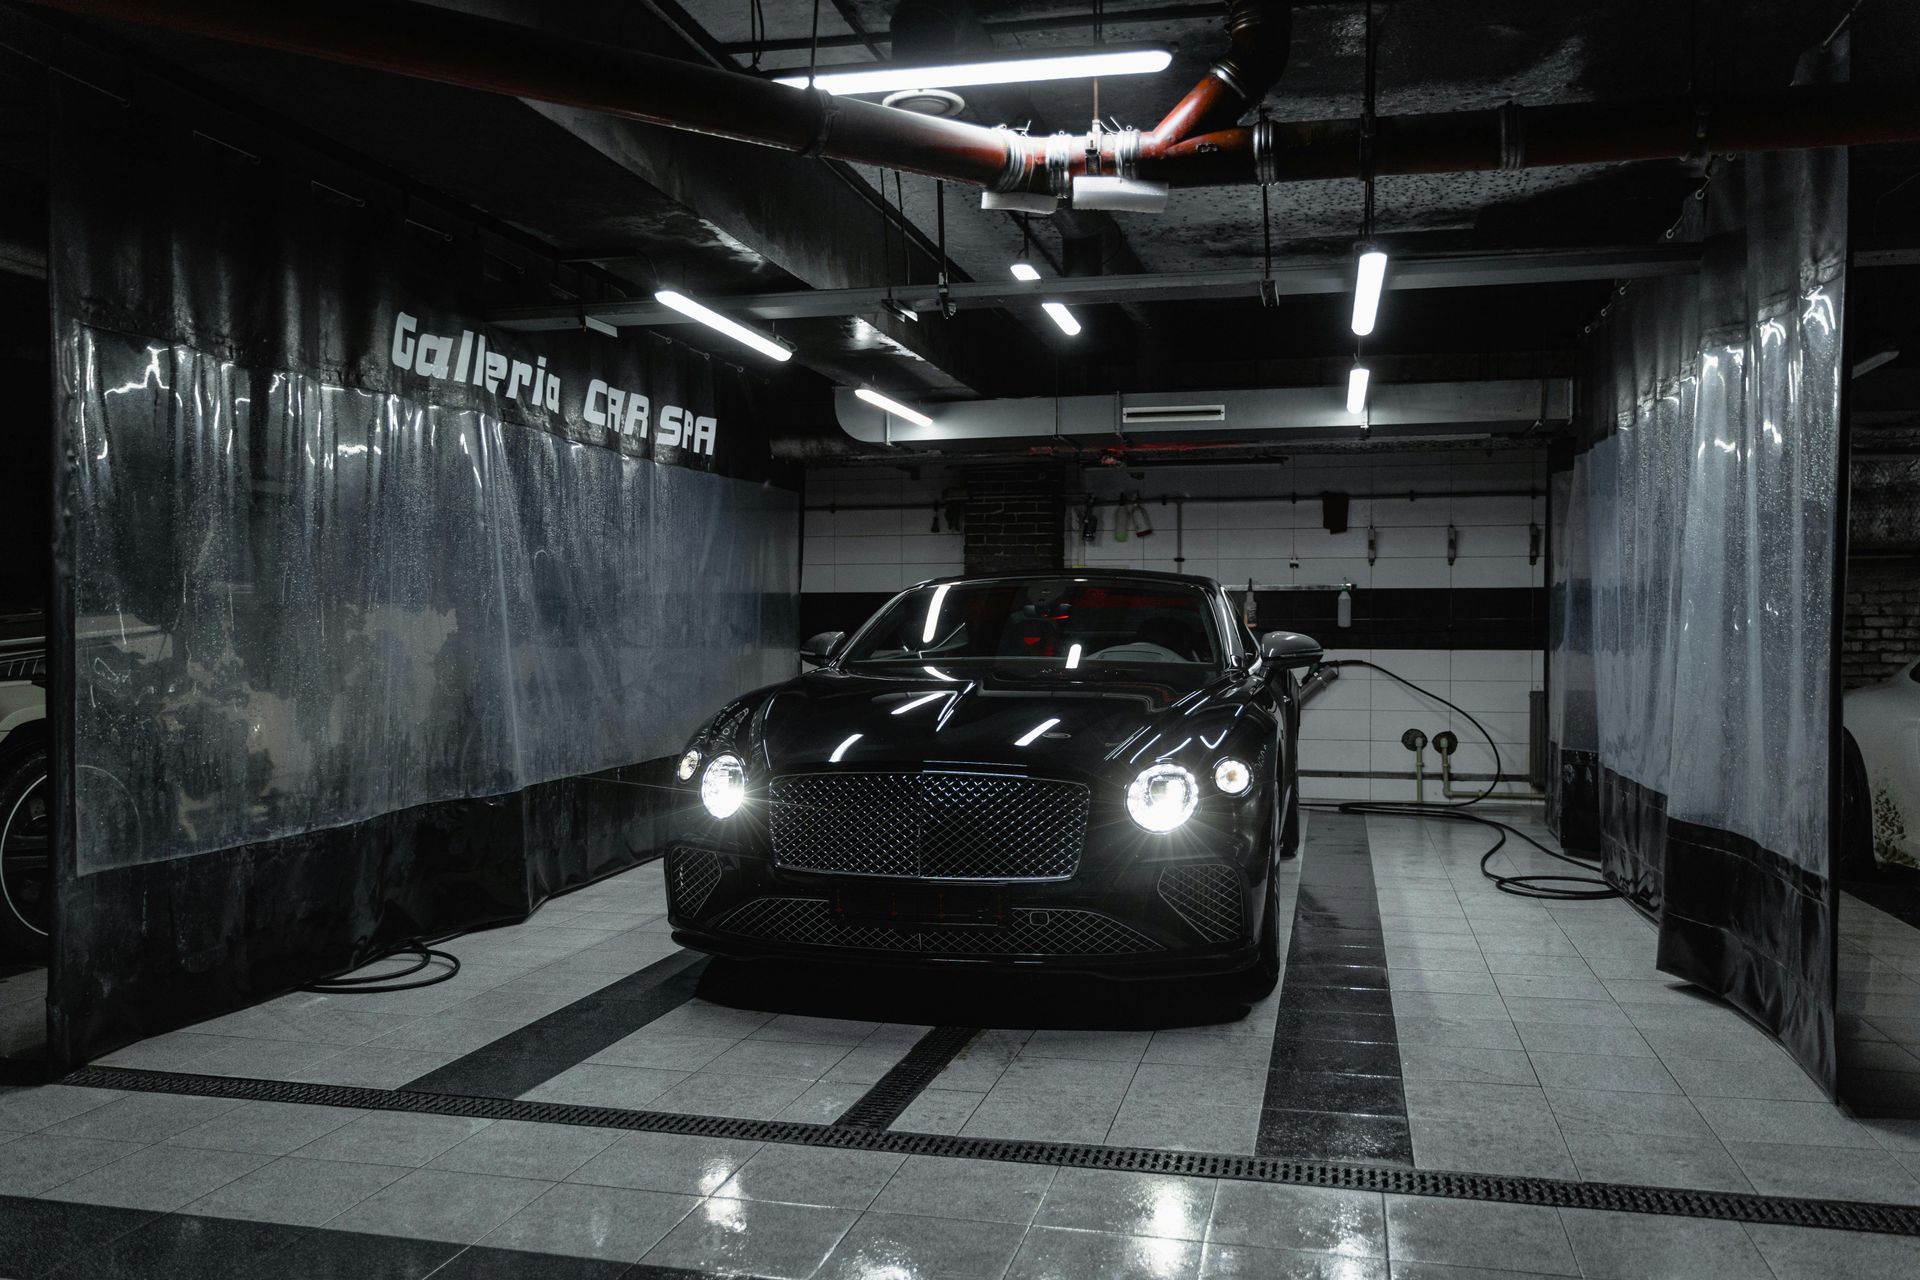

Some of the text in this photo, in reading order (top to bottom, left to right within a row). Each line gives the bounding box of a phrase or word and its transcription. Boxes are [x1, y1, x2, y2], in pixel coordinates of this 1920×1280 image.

[392, 311, 717, 455] Galleria CAR SPA
